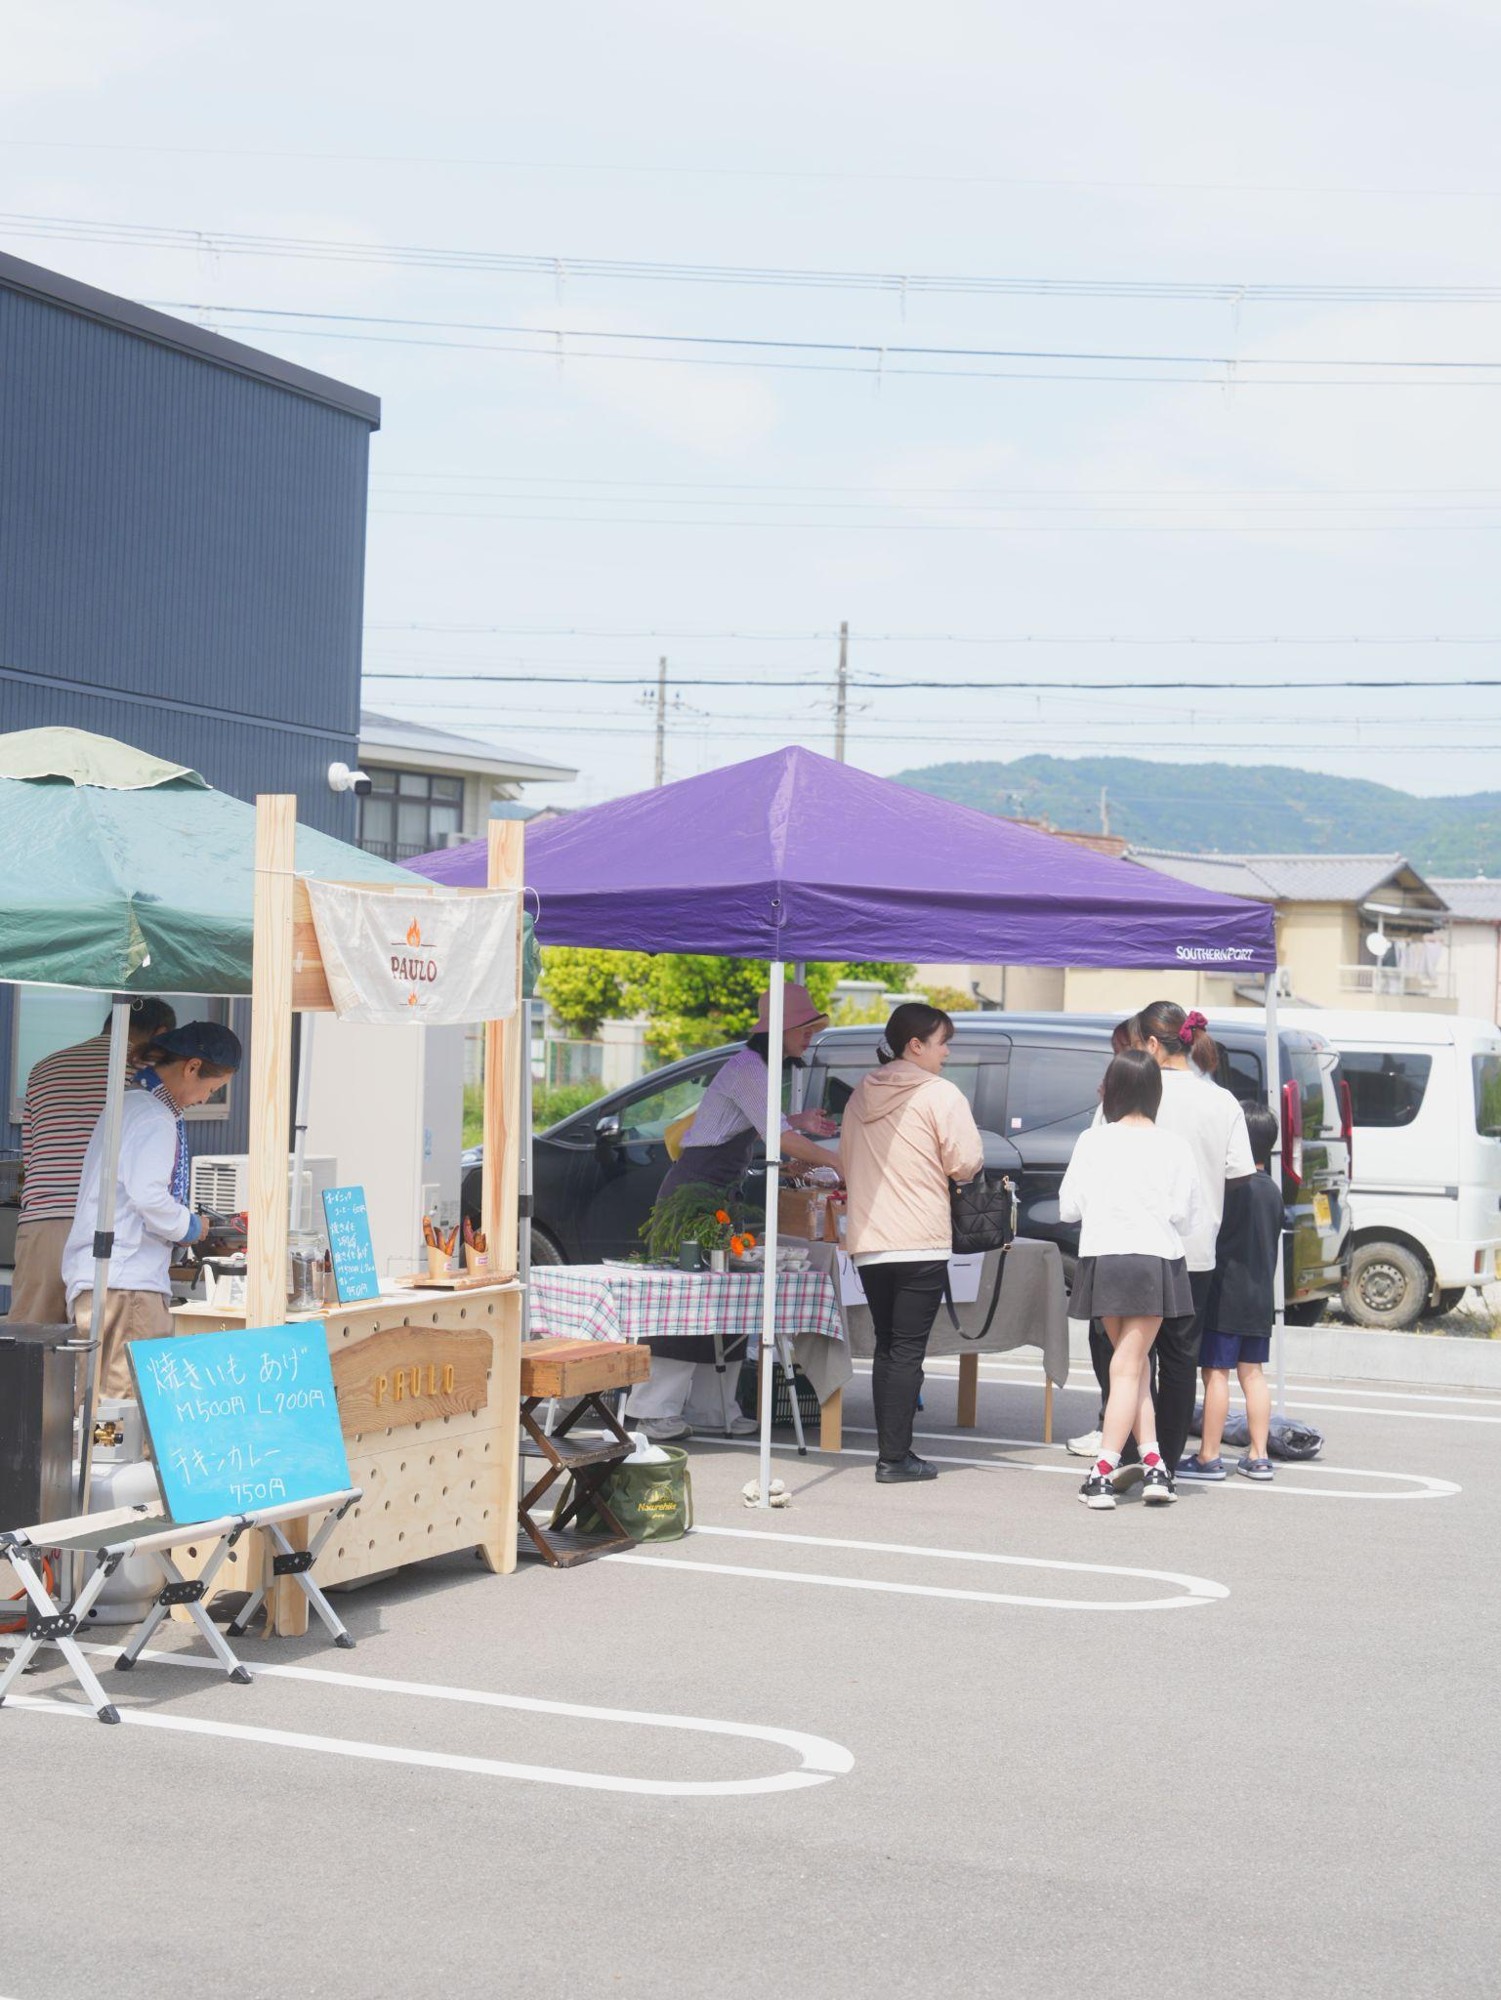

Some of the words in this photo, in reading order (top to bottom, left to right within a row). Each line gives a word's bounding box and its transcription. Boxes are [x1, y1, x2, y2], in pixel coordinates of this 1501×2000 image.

[390, 956, 437, 983] PAULO
[147, 1351, 246, 1396] 焼きいも
[374, 1363, 454, 1408] PAULO
[171, 1443, 282, 1485] チキンカレー
[230, 1478, 287, 1504] 750円
